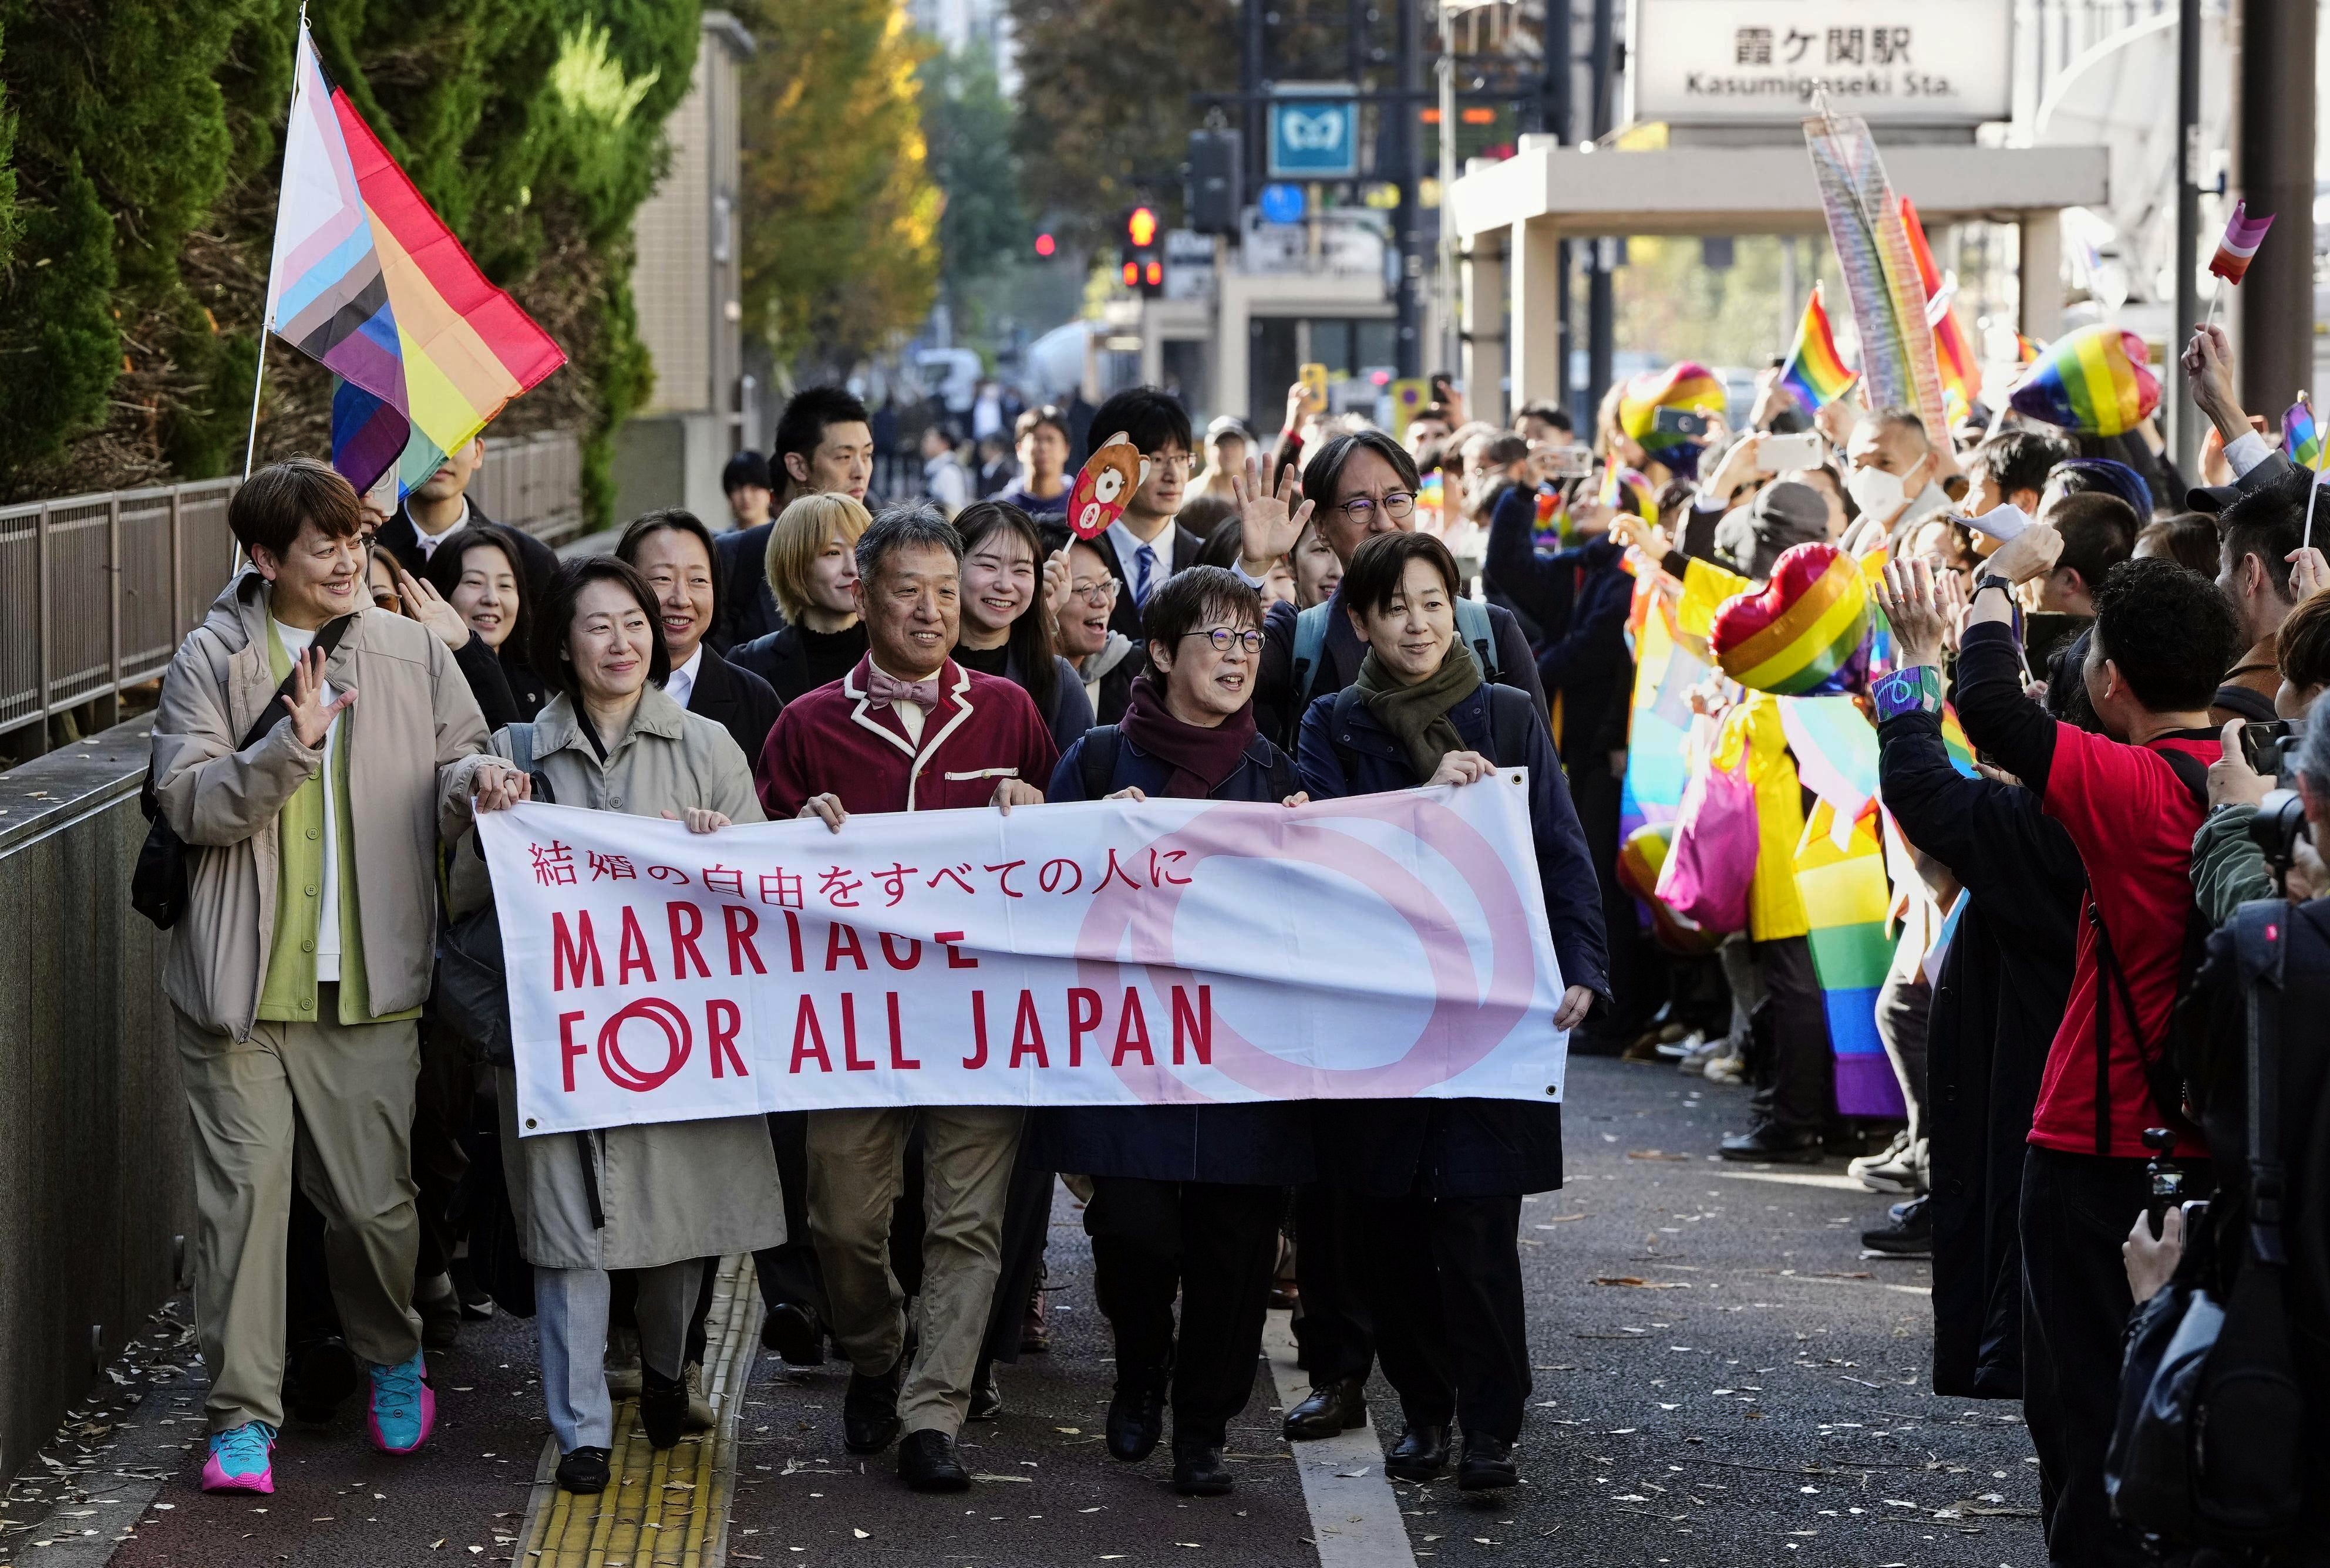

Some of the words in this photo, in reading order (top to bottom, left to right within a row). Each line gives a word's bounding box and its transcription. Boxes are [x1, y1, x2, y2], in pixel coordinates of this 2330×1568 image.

[1736, 26, 1911, 65] 霞ケ関駅
[1685, 70, 1892, 102] Kasumigaseki
[1904, 71, 1958, 96] Sta.
[527, 839, 1193, 910] 結婚の自由をすべての人に
[558, 997, 749, 1092] FOR
[789, 991, 921, 1074] ALL
[962, 985, 1213, 1070] JAPAN
